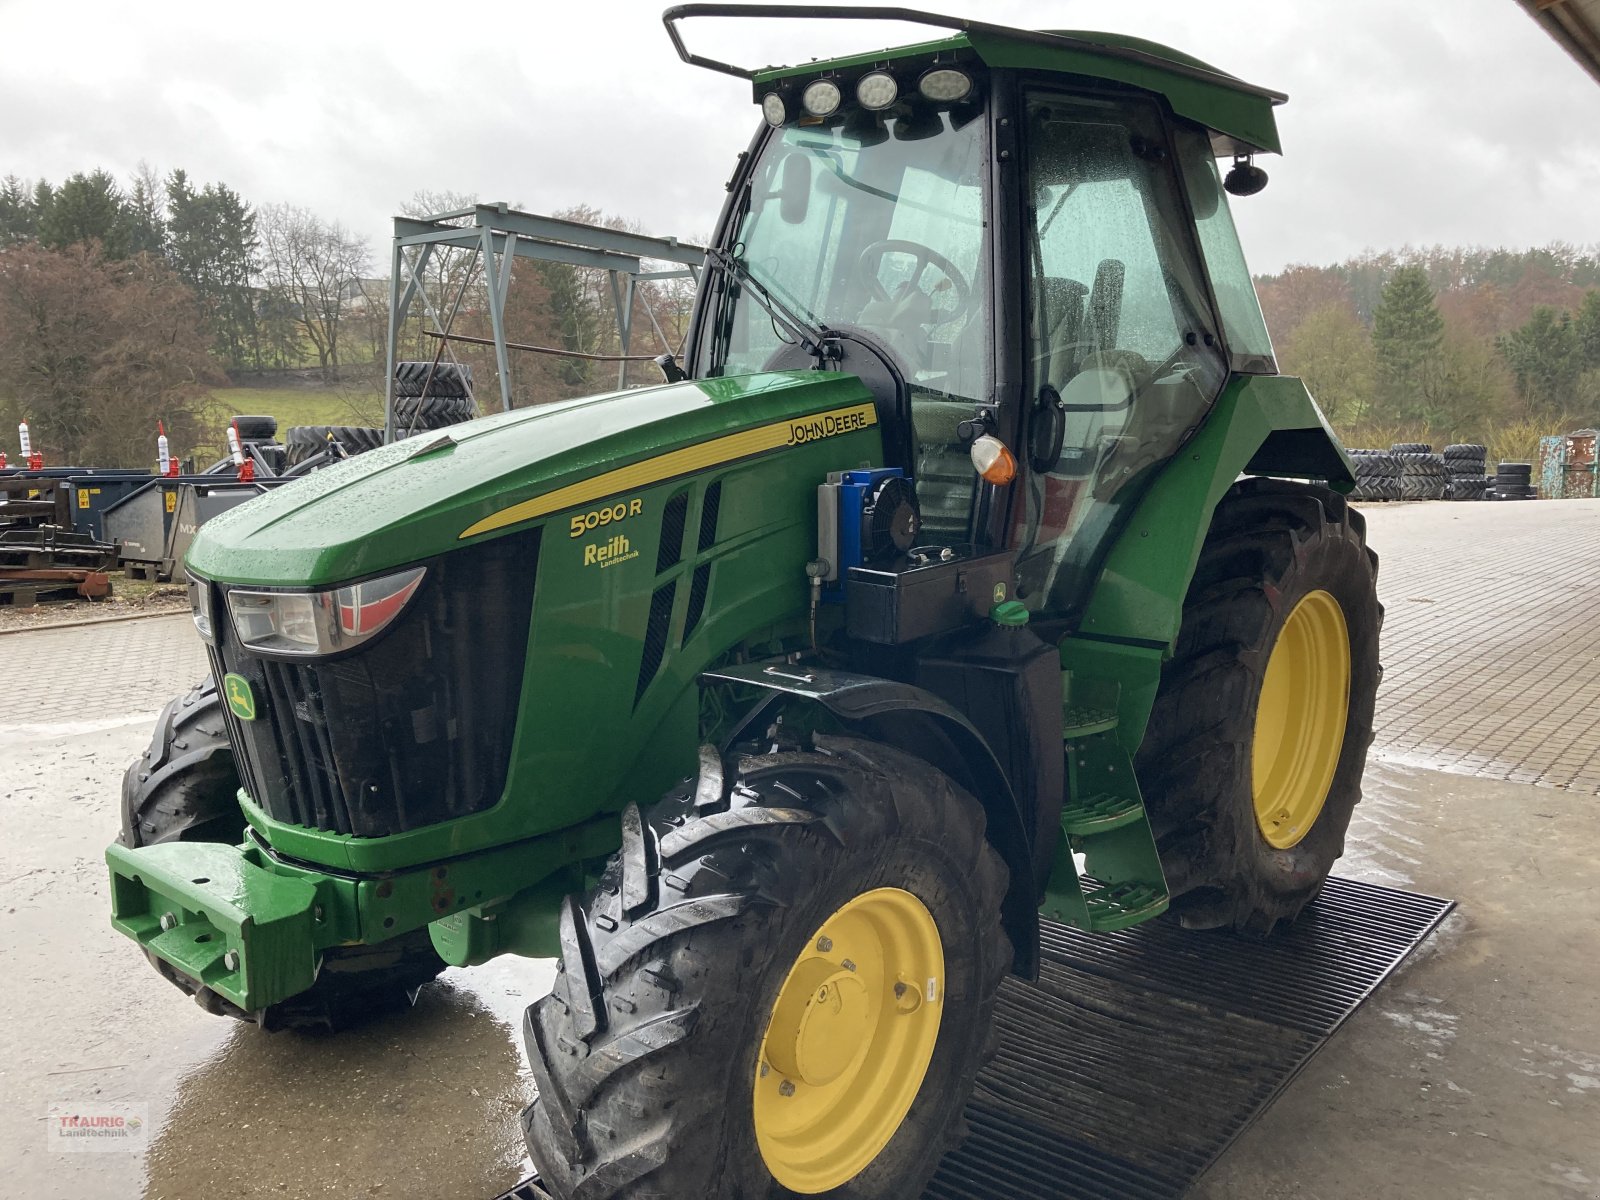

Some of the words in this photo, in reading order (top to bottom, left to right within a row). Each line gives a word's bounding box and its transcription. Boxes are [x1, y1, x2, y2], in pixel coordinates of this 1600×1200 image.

[787, 421, 825, 444] JOHN
[824, 411, 867, 434] DEERE
[570, 503, 627, 538] 5090
[629, 498, 643, 518] R
[584, 534, 630, 567] Reith
[600, 549, 640, 569] Landtechnik
